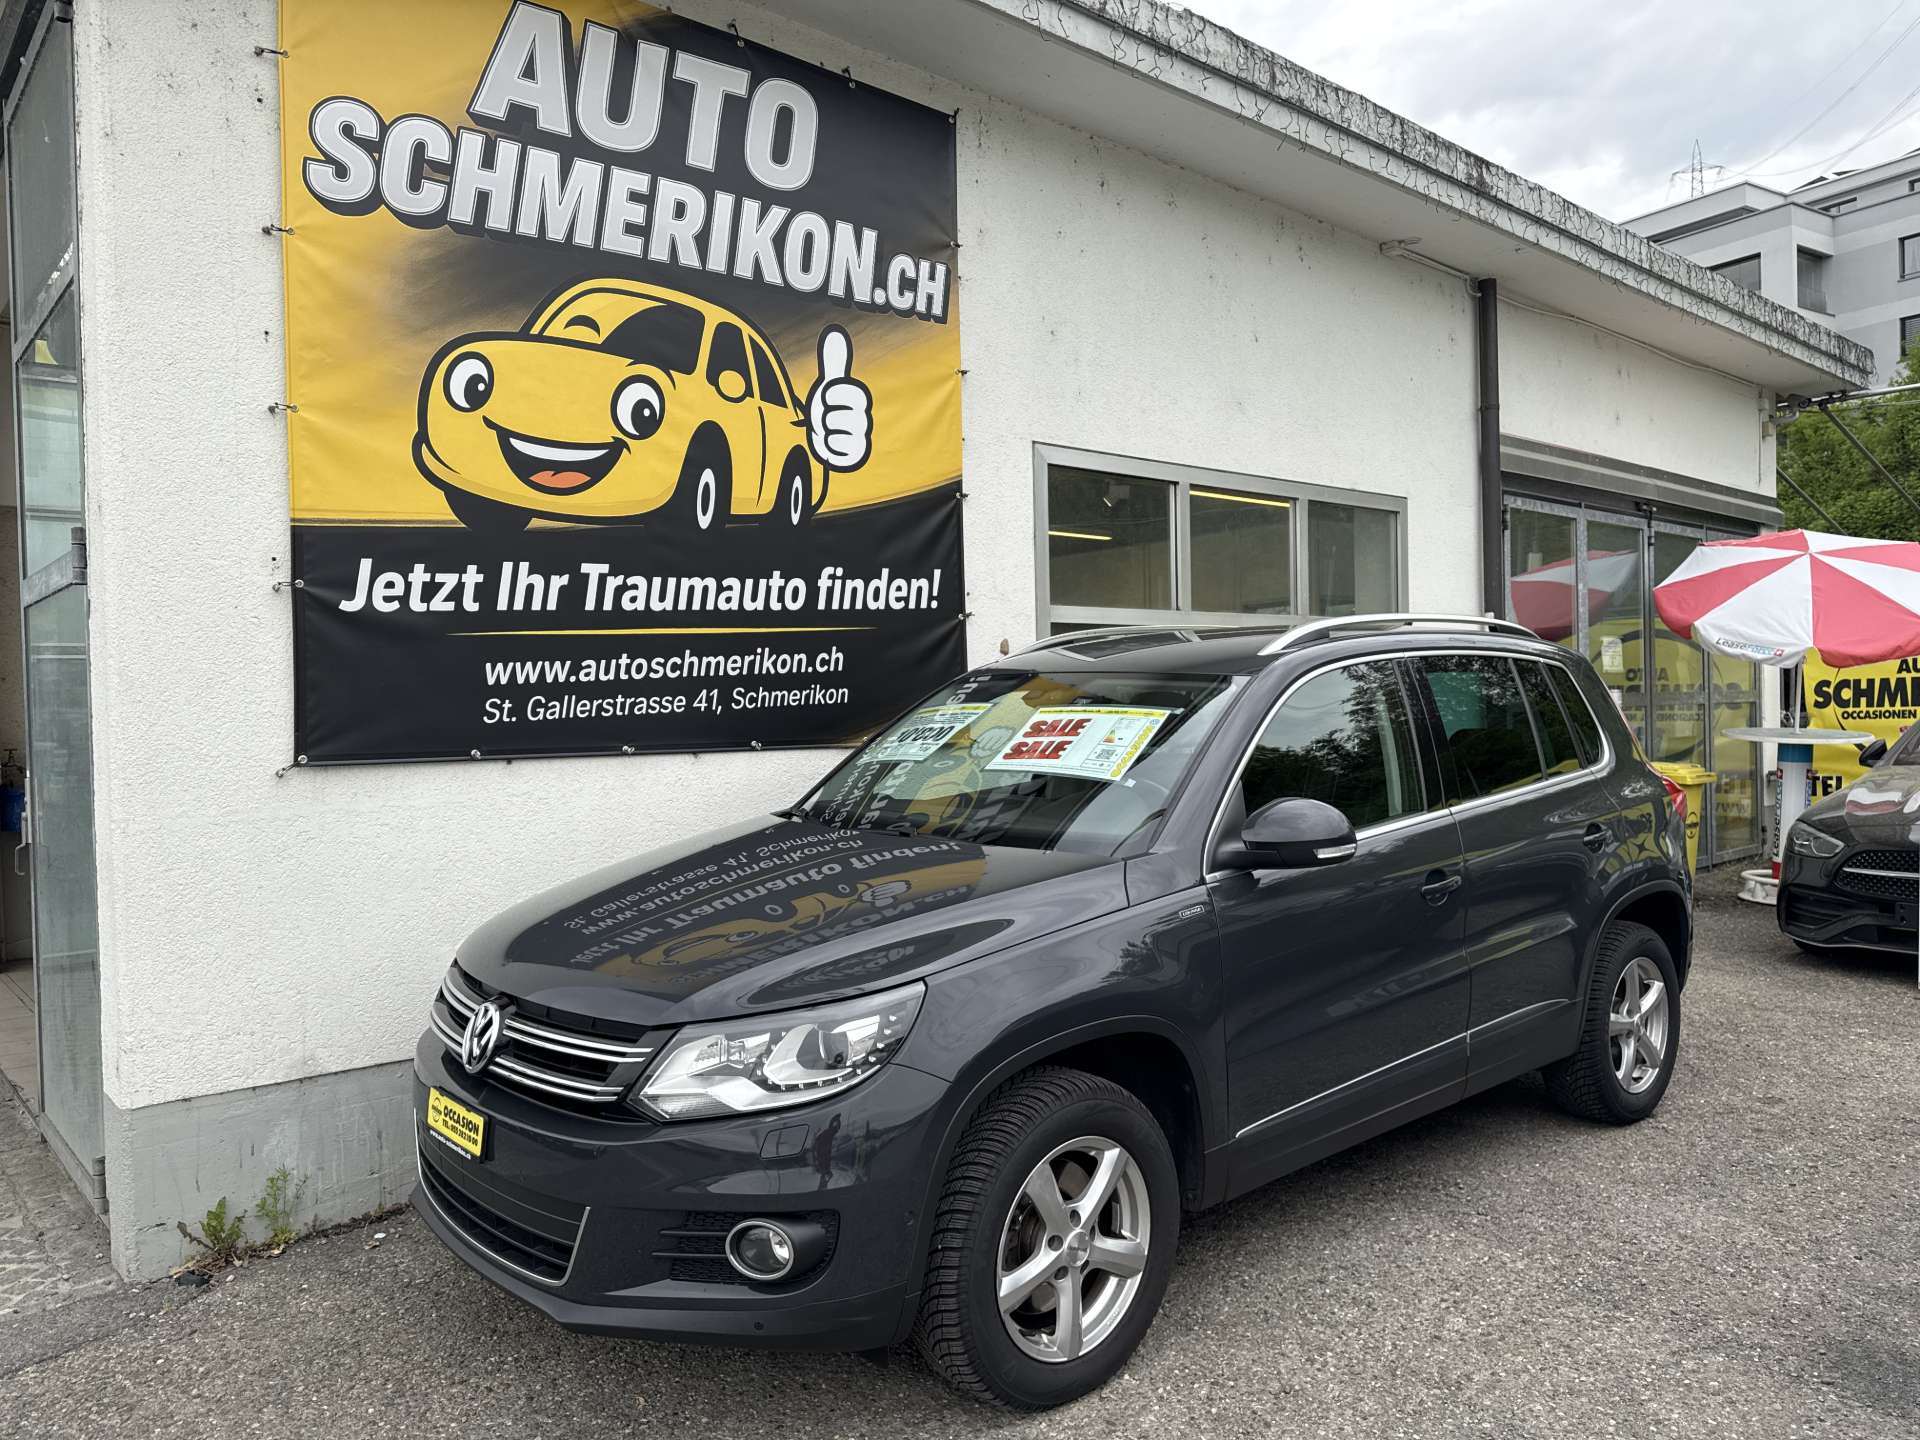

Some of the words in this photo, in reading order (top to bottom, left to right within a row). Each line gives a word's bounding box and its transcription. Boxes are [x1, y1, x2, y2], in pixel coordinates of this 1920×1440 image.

[470, 0, 819, 191] AUTO
[305, 98, 948, 318] SCHMERIKON.CH
[338, 557, 484, 613] Jetzt
[496, 562, 568, 612] Ihr
[581, 563, 804, 612] Traumauto
[816, 566, 942, 611] finden!
[485, 646, 844, 685] www.autoschmerikon.ch
[482, 697, 517, 724] St.
[527, 693, 686, 721] Gallerstrasse
[693, 689, 723, 715] 41,
[731, 685, 849, 709] Schmerikon
[1842, 709, 1918, 720] OCCASIONEN
[1022, 718, 1093, 738] SALE
[1002, 740, 1074, 760] SALE
[443, 1104, 480, 1137] OCCASION
